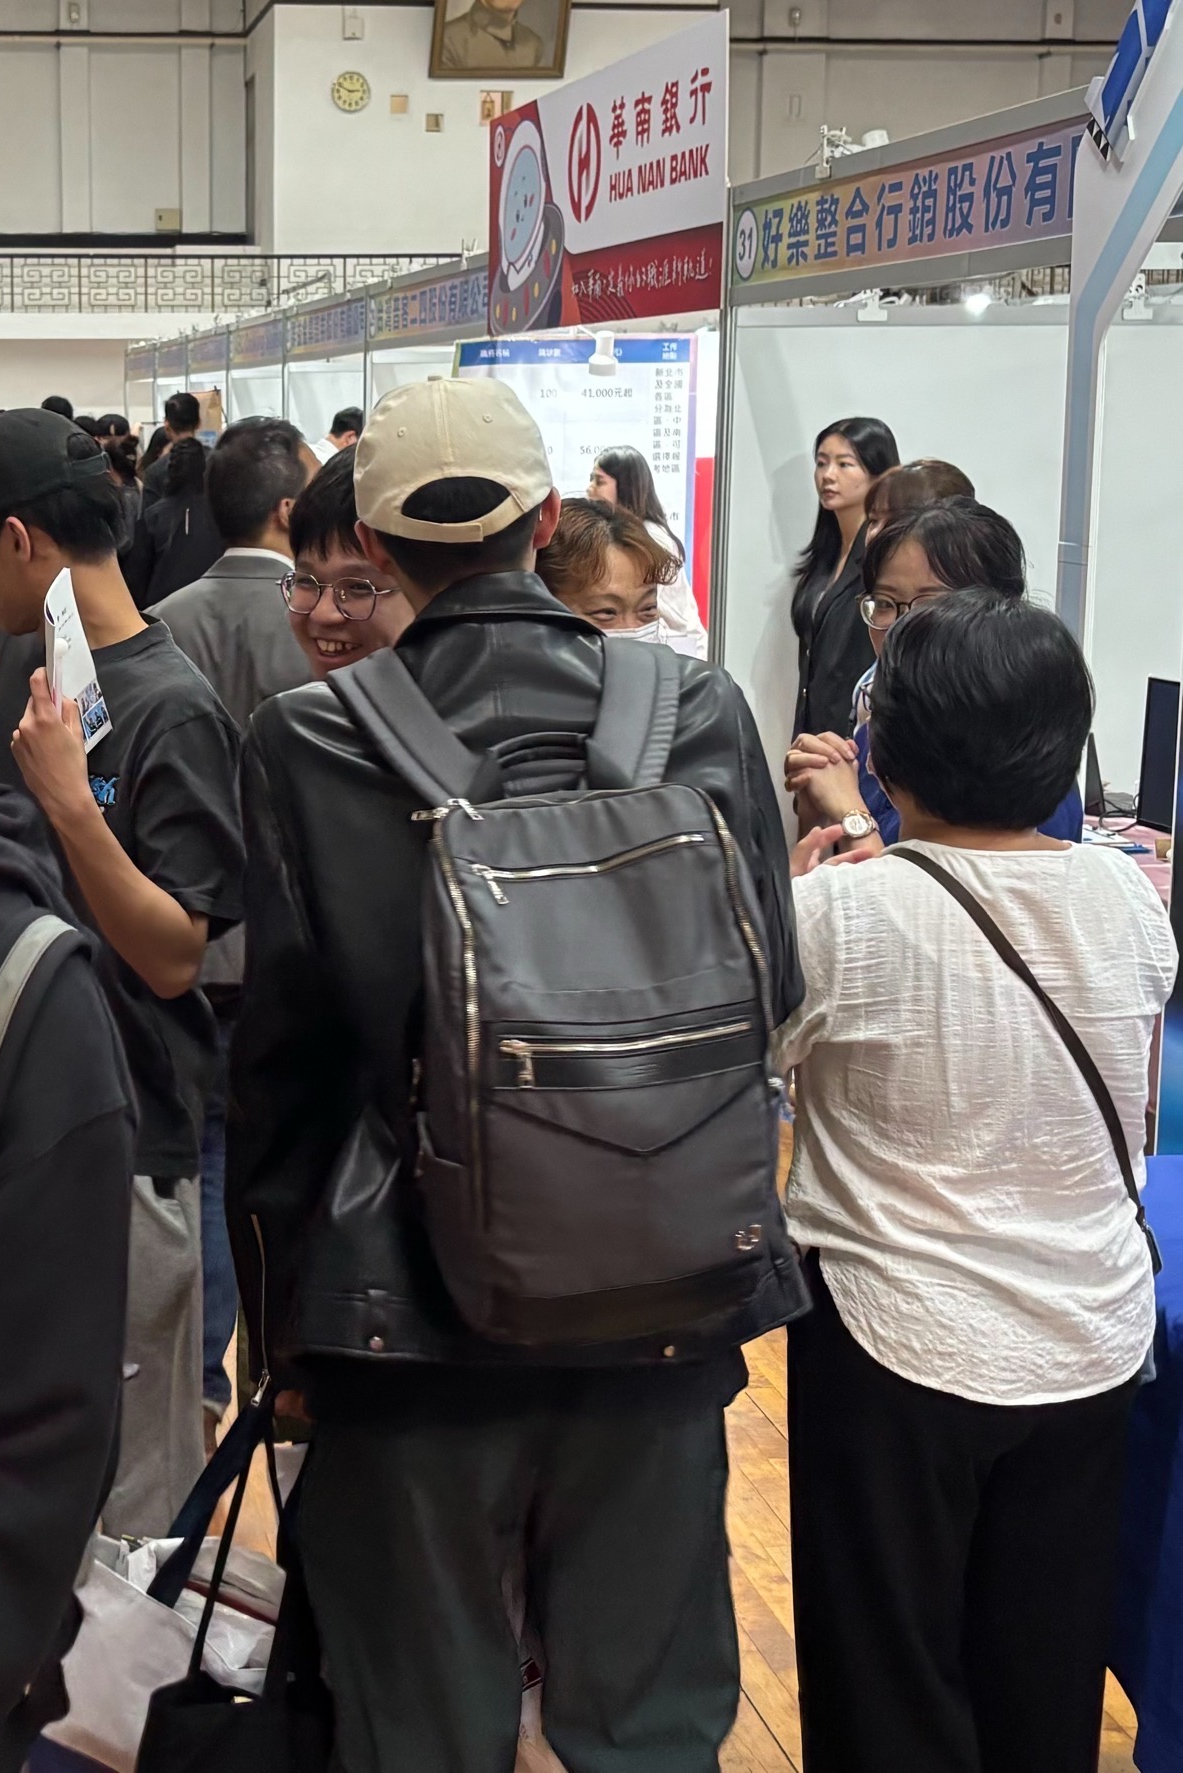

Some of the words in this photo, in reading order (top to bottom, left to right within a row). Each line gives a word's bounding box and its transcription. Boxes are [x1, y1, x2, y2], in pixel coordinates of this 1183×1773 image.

[609, 67, 713, 160] 華南銀行
[609, 168, 634, 203] HUA
[637, 158, 666, 196] NAN
[670, 143, 711, 186] BANK
[738, 227, 754, 263] 31
[761, 134, 1075, 270] 好樂整合行銷股份有
[540, 388, 558, 398] 100
